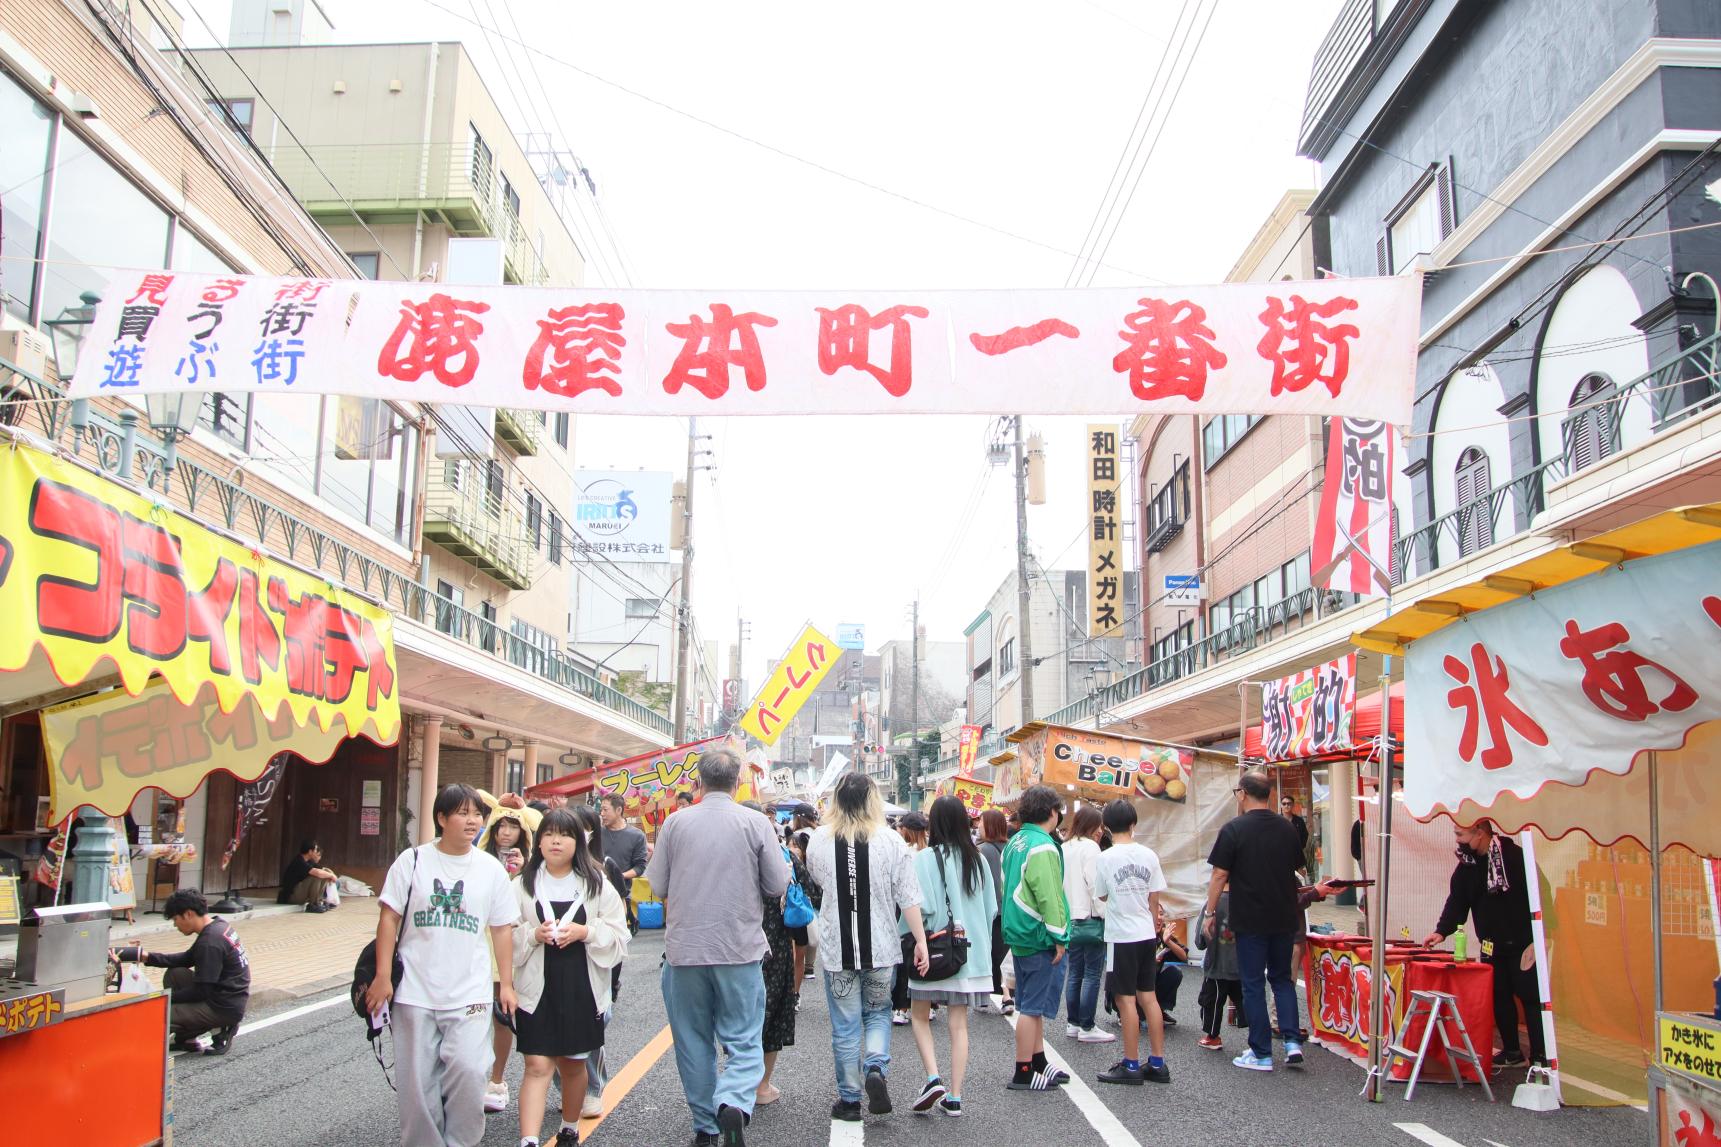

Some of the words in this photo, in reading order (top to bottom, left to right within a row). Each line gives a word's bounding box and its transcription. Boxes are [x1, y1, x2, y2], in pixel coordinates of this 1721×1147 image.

[114, 302, 318, 344] 買う街
[100, 339, 305, 388] 遊ぶ街
[1092, 431, 1115, 481] 和田
[1093, 490, 1117, 541] 時計
[1095, 550, 1118, 629] メガネ
[1054, 743, 1156, 776] Cheese
[1077, 764, 1131, 788] Ball
[847, 846, 857, 878] DIVERSE
[413, 911, 480, 934] GREATNESS
[1671, 1024, 1715, 1050] かき氷に
